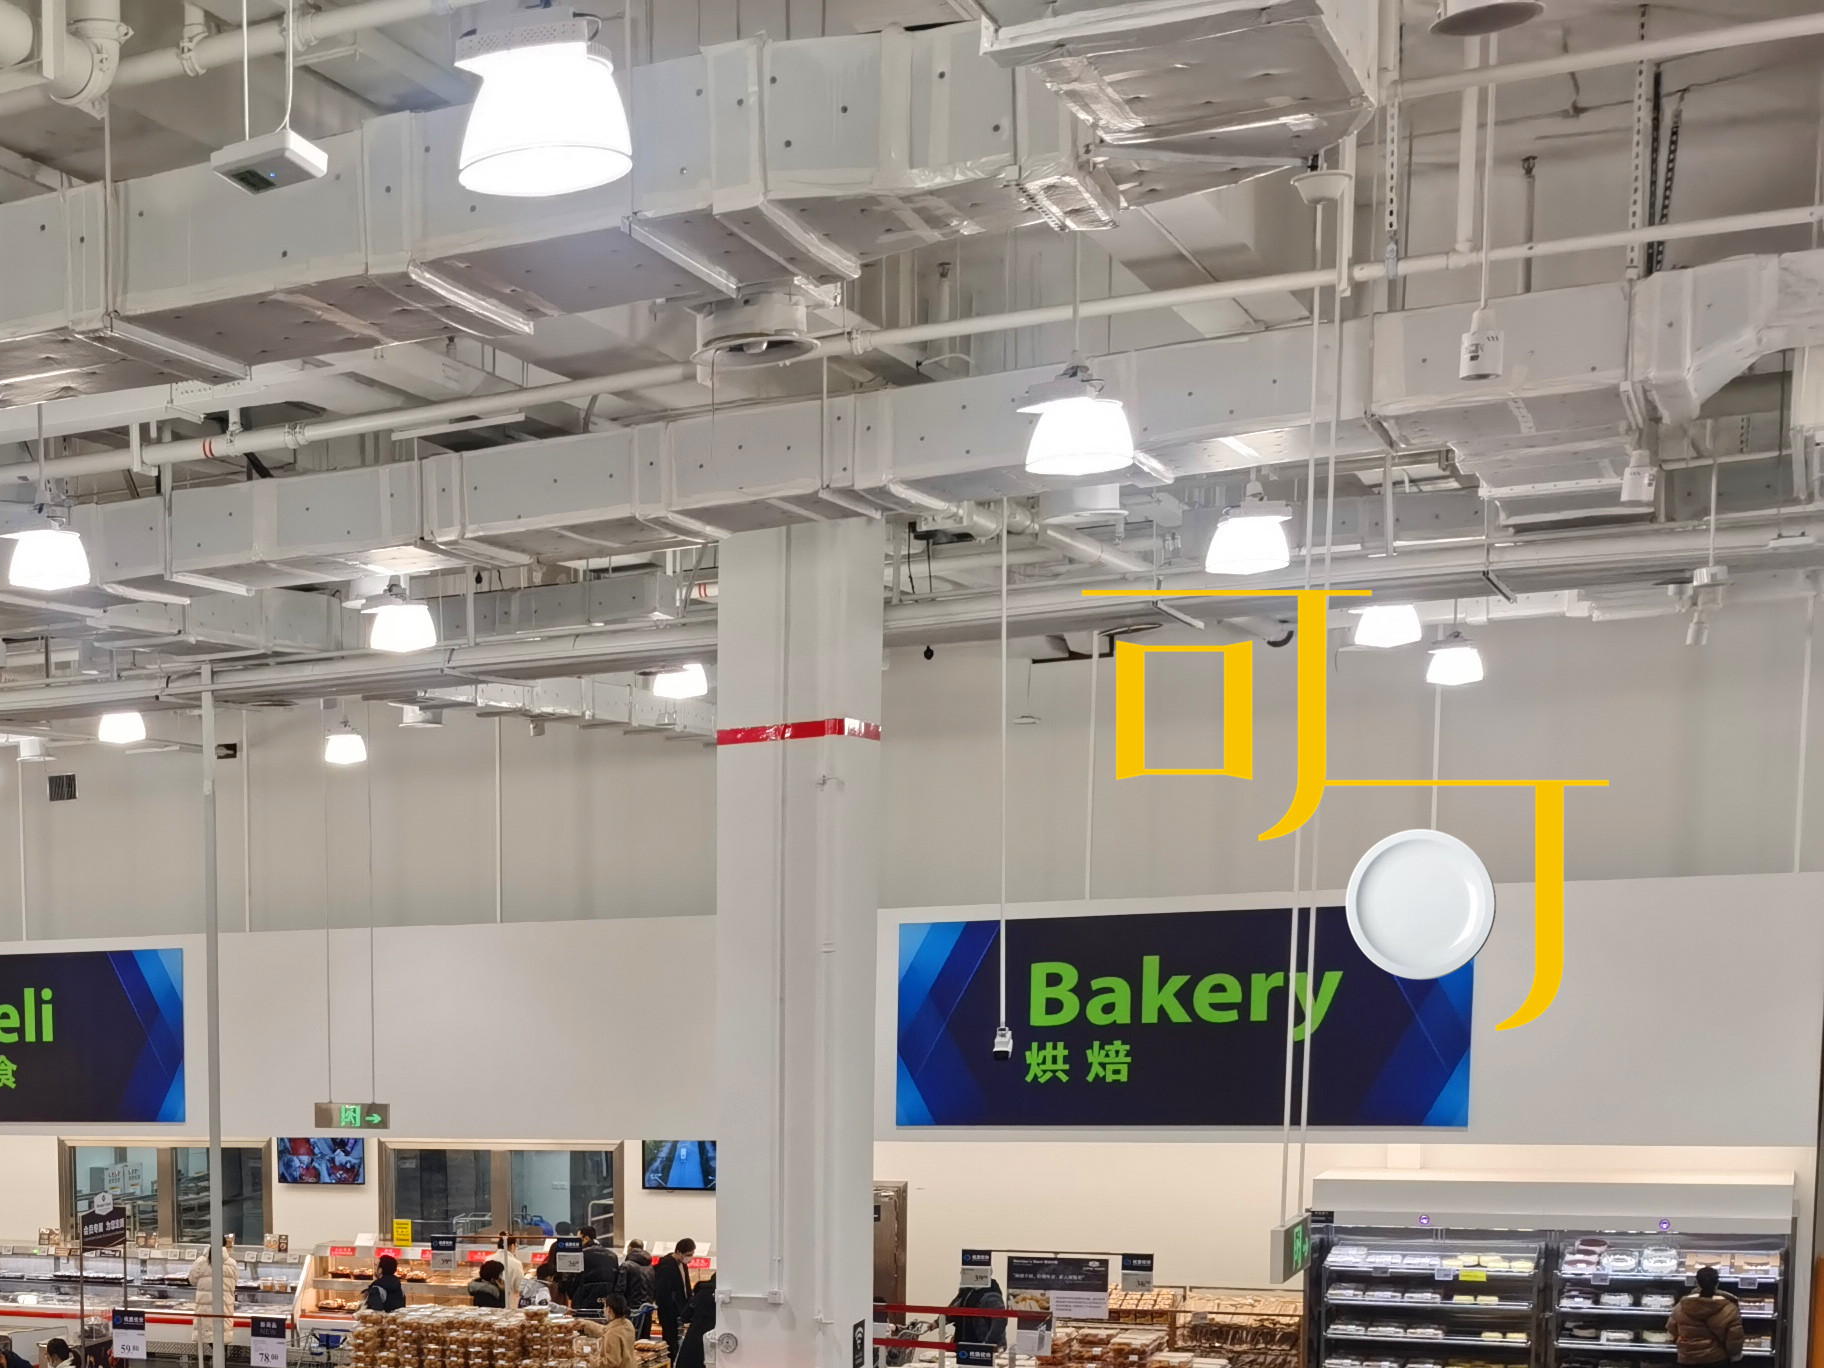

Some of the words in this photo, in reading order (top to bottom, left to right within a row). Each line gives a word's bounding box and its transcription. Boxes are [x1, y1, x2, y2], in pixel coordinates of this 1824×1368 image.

[1029, 955, 1344, 1042] Bakery
[1025, 1040, 1132, 1084] 烘焙
[259, 1352, 279, 1363] 78.00
